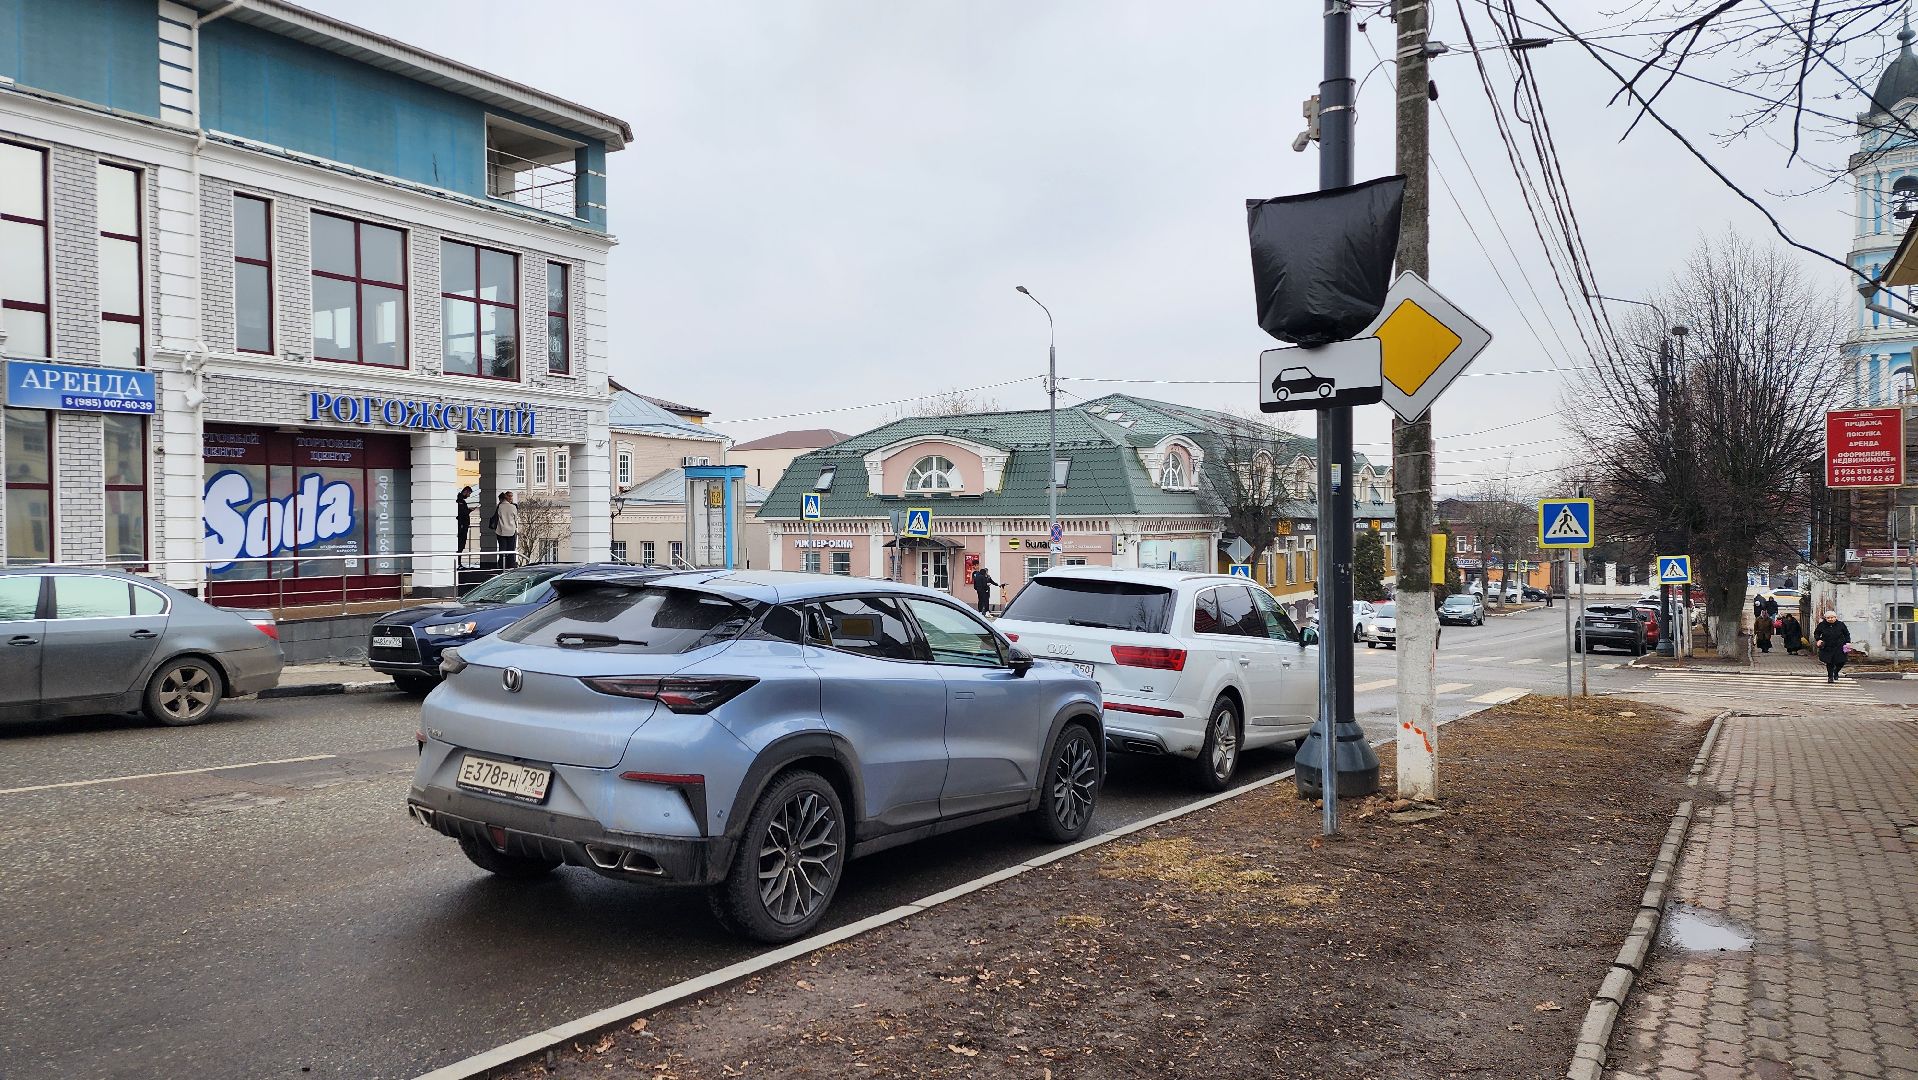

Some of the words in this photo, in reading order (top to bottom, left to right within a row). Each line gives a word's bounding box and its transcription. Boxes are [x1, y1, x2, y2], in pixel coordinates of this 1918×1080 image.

[20, 368, 144, 399] АРЕНДА
[65, 397, 73, 406] 8
[75, 397, 101, 408] (985)
[104, 399, 152, 410] 007-60-39
[306, 391, 536, 435] РОГОЖСКИЙ
[202, 433, 260, 444] РГОВЫЙ
[1846, 430, 1882, 438] ПОКУПКА
[1832, 456, 1896, 464] НЕДВИЖИМОСТИ
[1837, 450, 1891, 458] ОФОРМЛЕНИЕ
[204, 470, 354, 573] Soda
[795, 539, 853, 549] МАТЕР-ОКНА
[463, 762, 519, 788] Е378РН
[521, 769, 545, 788] 790
